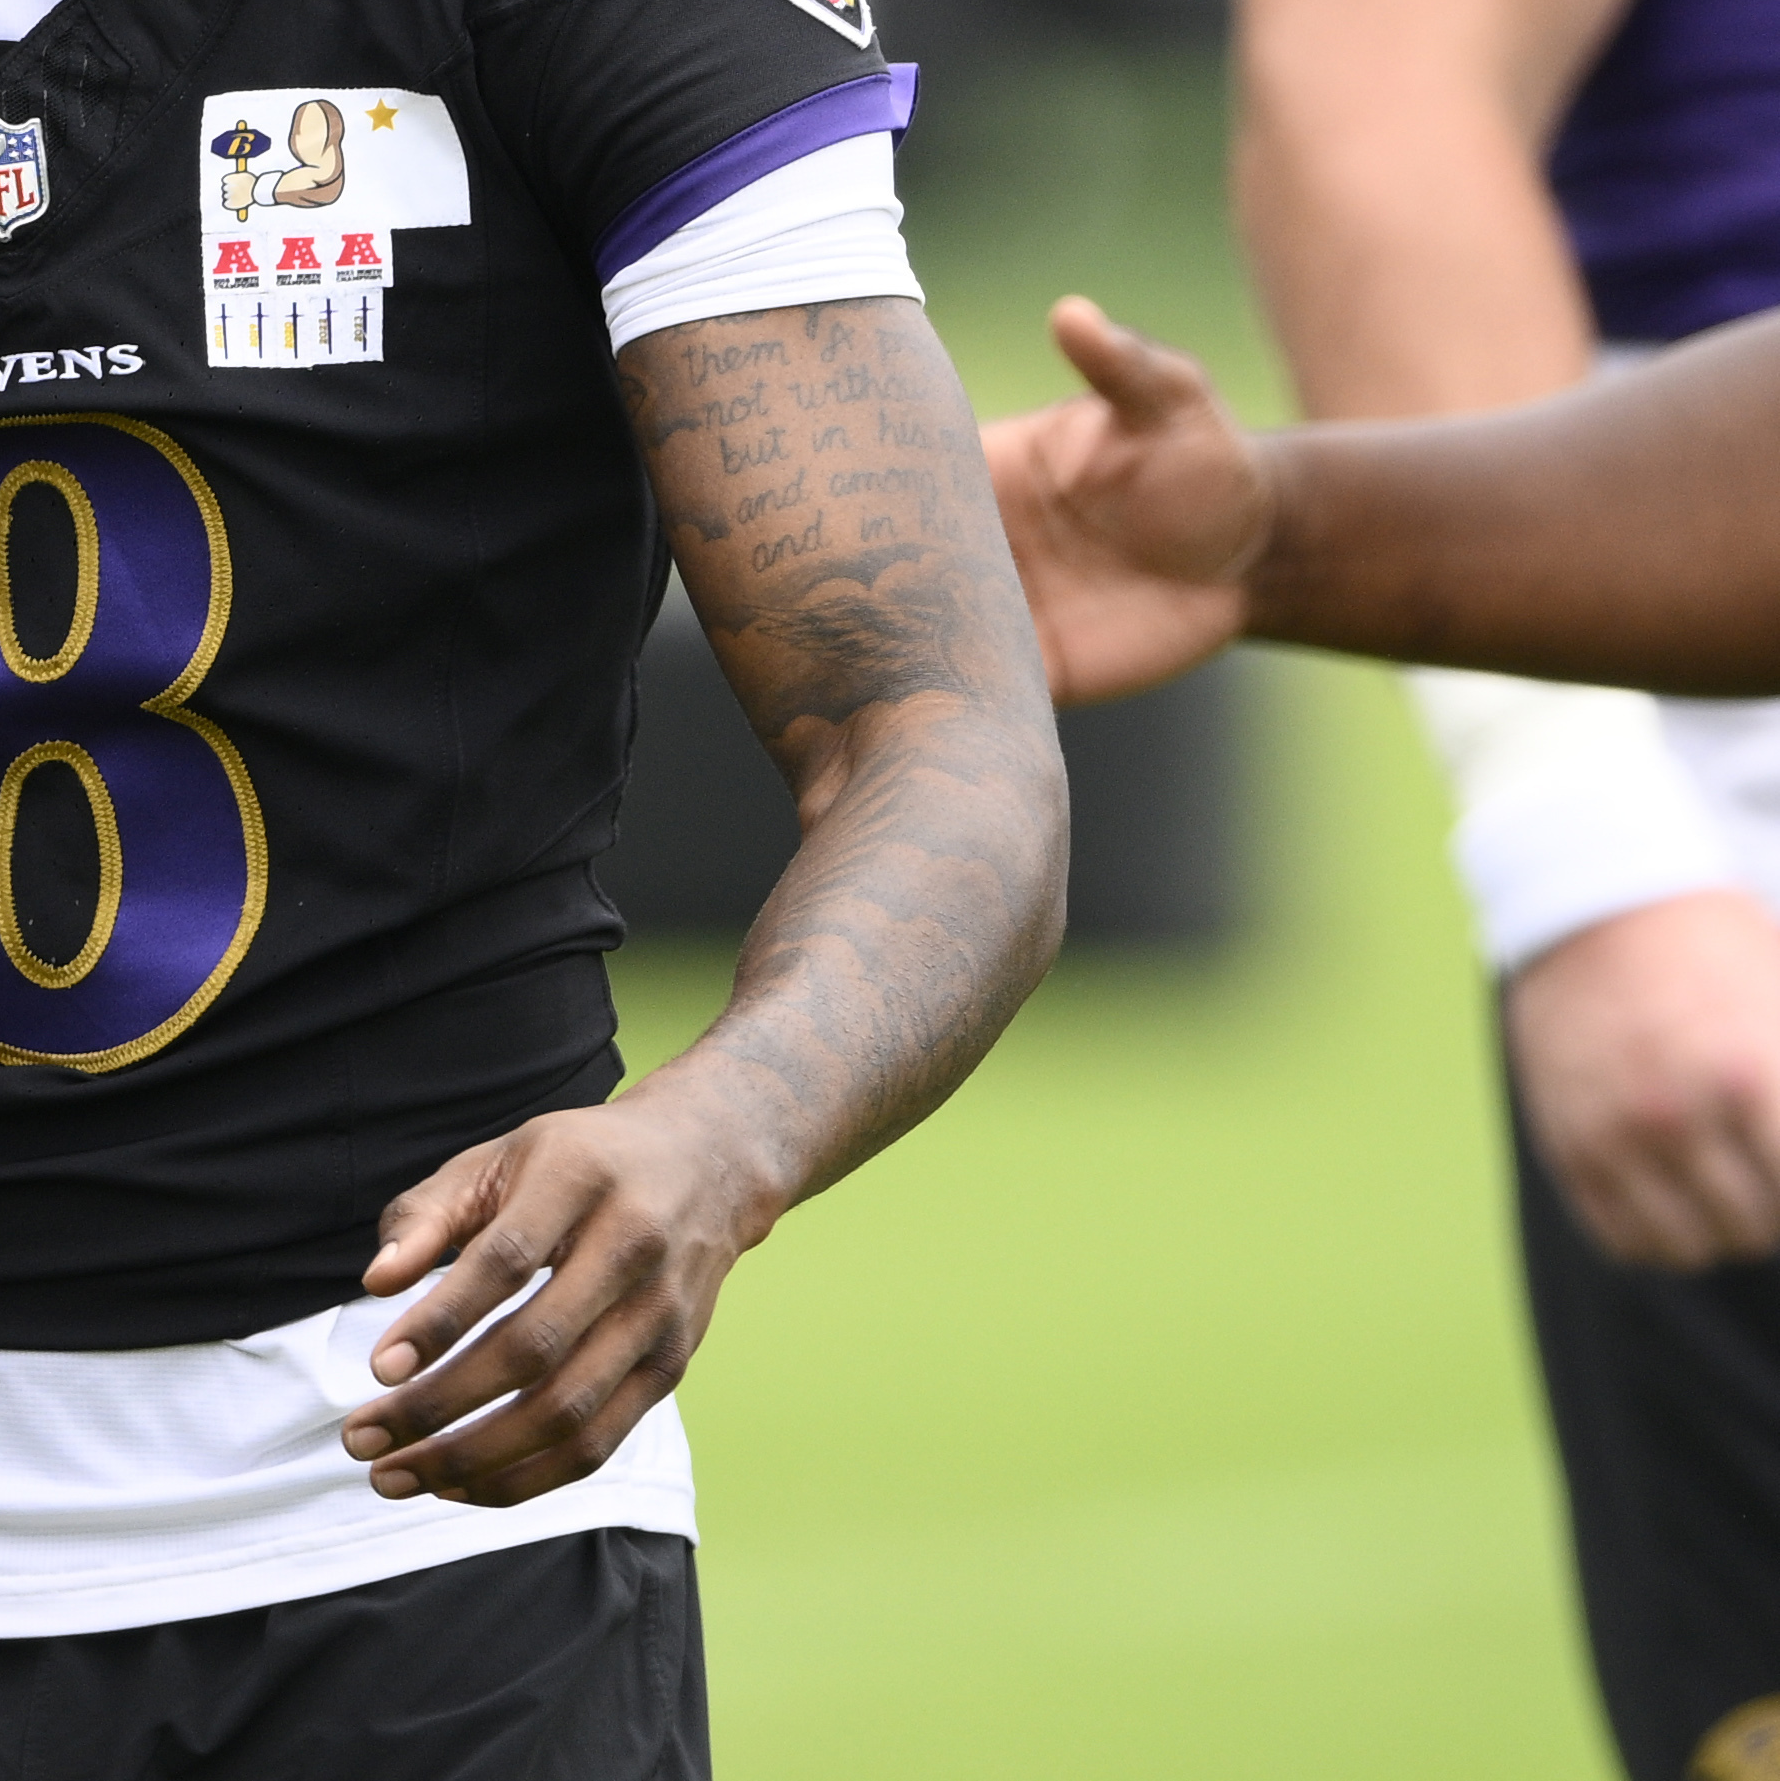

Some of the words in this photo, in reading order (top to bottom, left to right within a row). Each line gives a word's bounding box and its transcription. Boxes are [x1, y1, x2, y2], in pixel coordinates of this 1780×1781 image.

[213, 241, 259, 274] A
[276, 237, 322, 270] A
[335, 233, 382, 266] A
[319, 318, 328, 345] 2022
[681, 338, 791, 387] them
[705, 378, 769, 428] not
[719, 426, 791, 475] but
[812, 423, 851, 454] in
[735, 467, 812, 526] and
[751, 508, 832, 574] and
[860, 505, 899, 543] in
